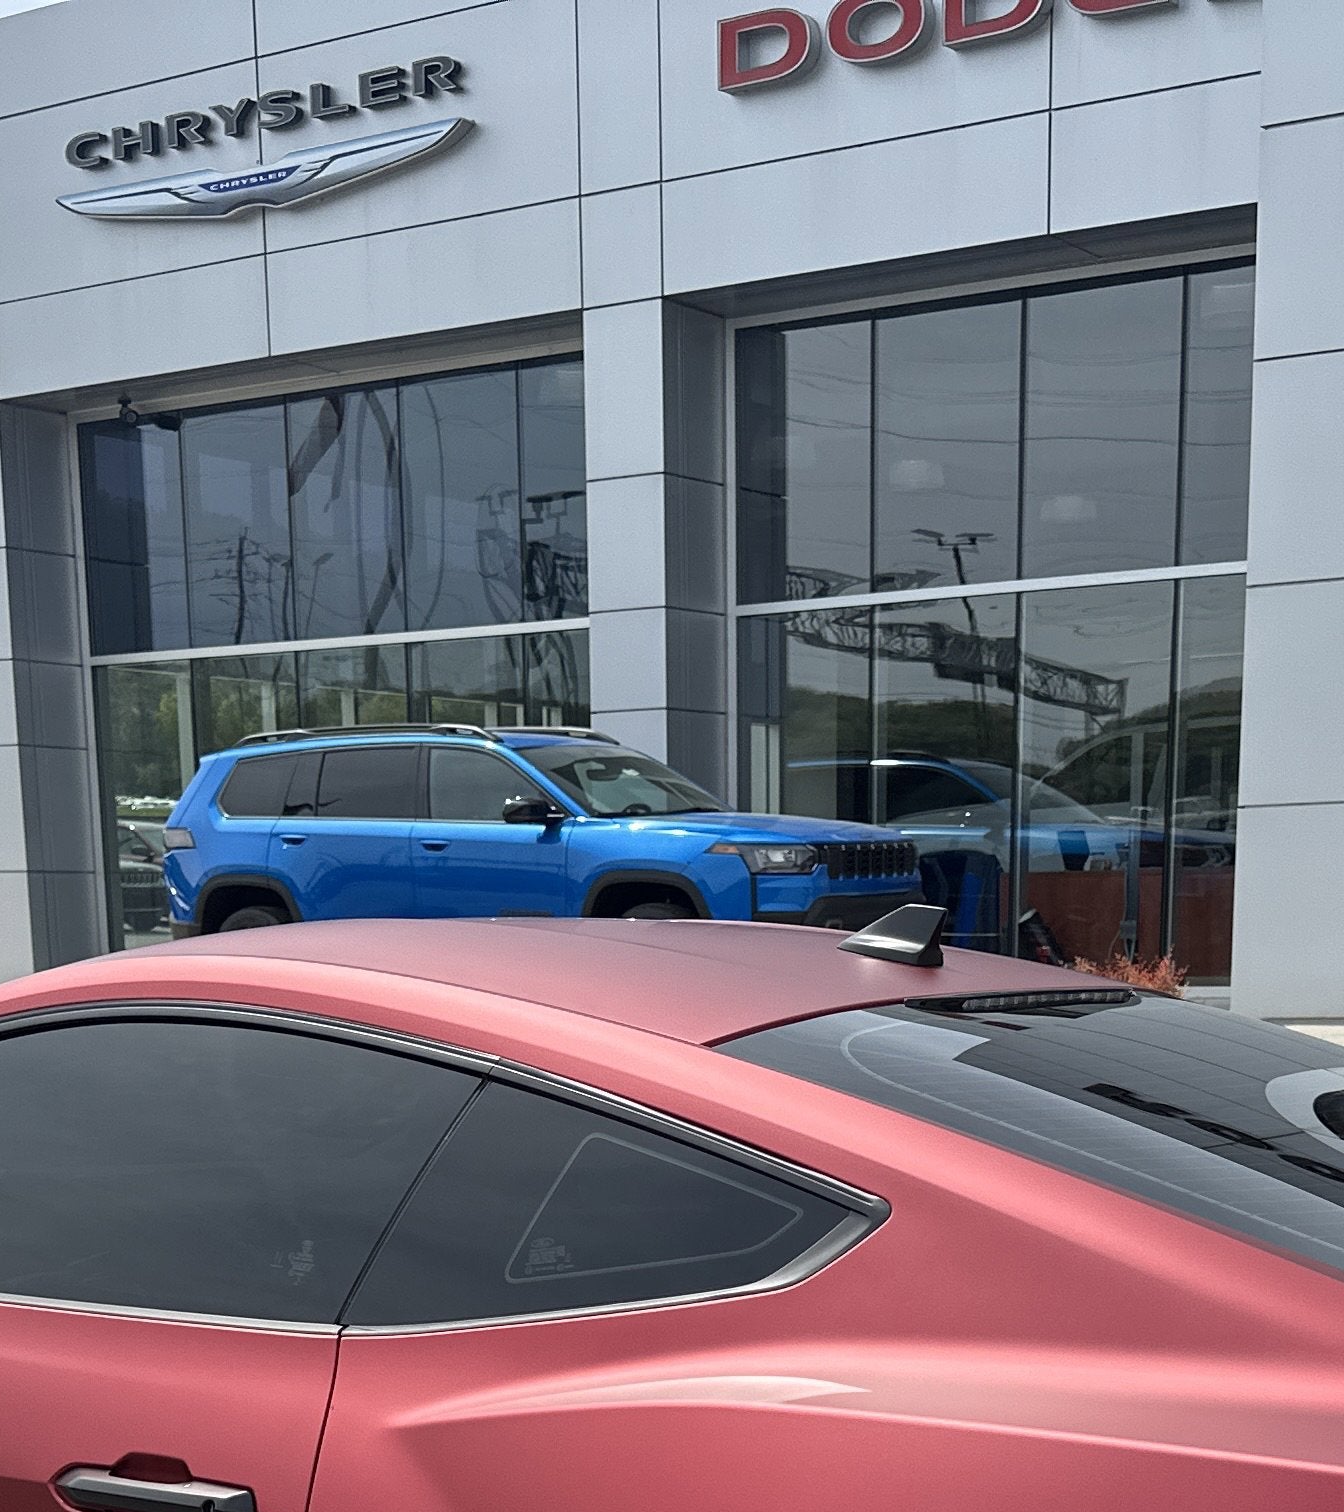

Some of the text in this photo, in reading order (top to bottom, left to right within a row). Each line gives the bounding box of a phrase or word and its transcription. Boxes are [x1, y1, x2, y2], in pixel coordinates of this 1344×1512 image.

[718, 0, 1184, 91] DOD
[64, 54, 462, 169] CHRYSLER
[209, 171, 287, 191] CHRYSLER
